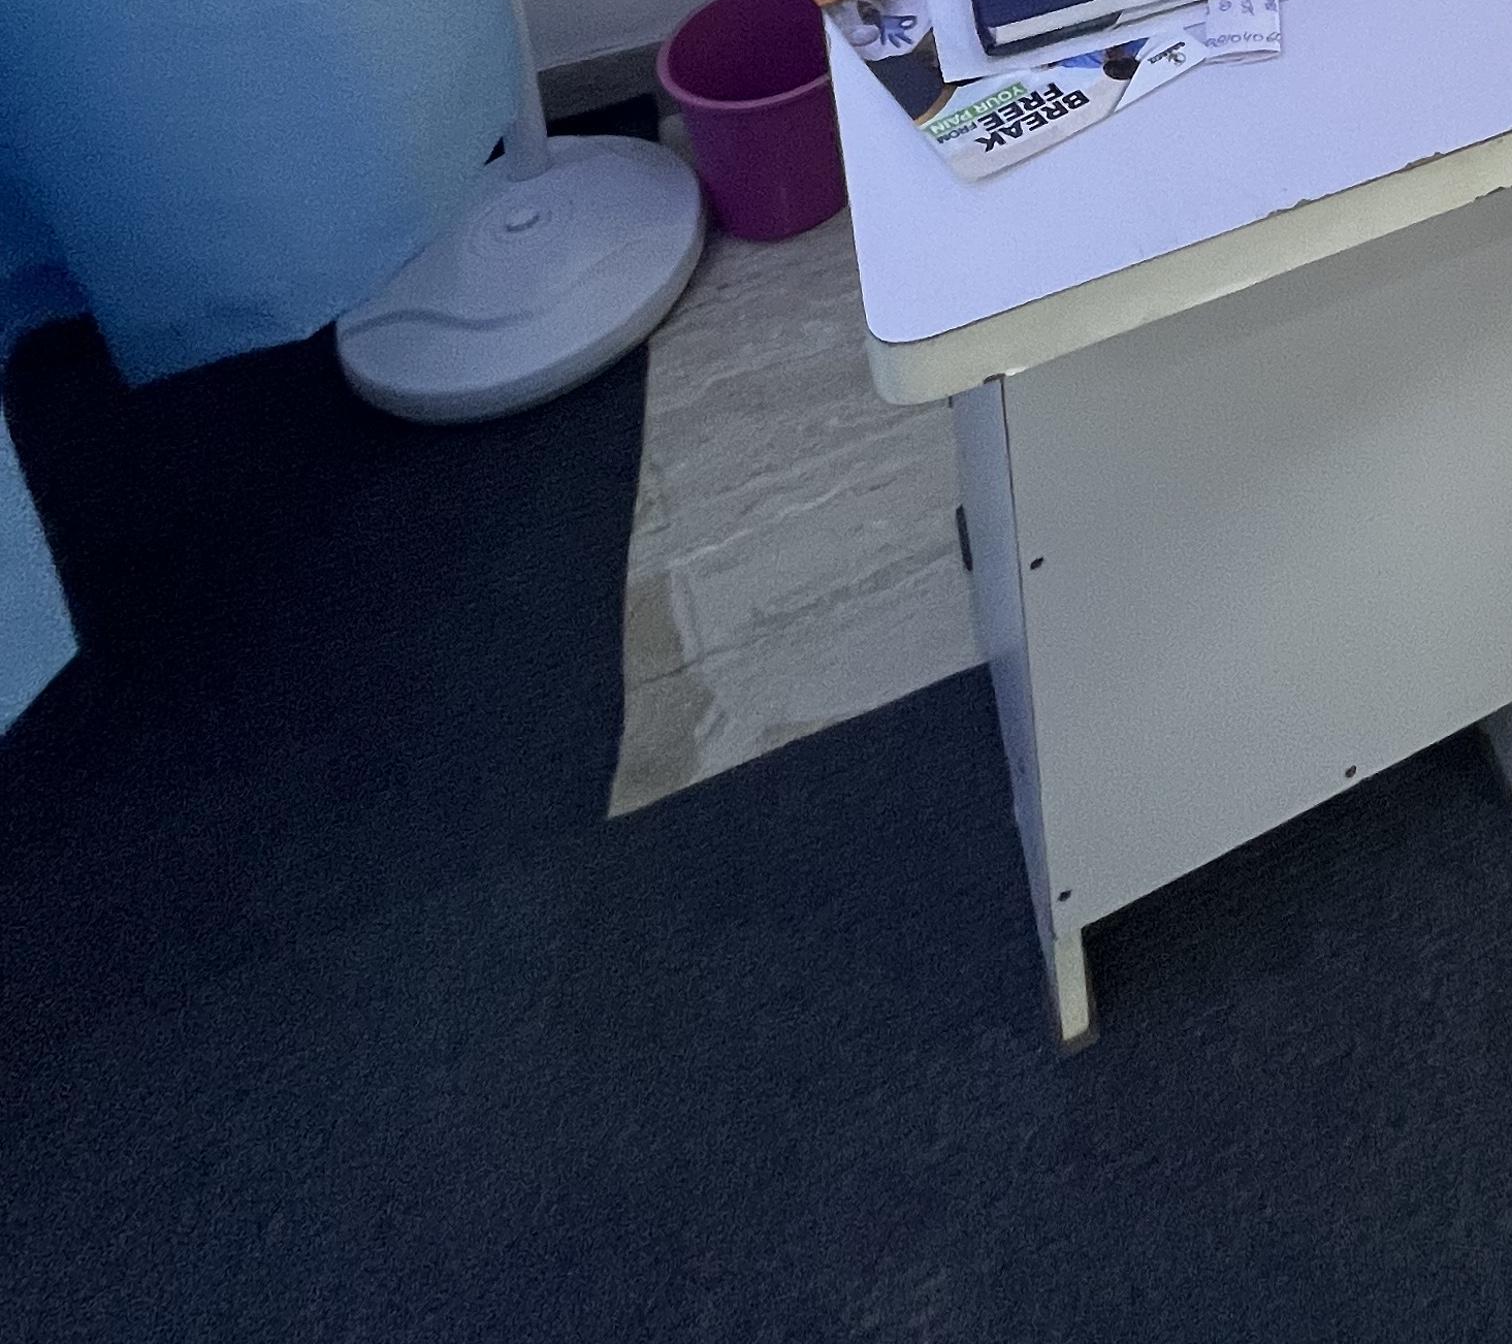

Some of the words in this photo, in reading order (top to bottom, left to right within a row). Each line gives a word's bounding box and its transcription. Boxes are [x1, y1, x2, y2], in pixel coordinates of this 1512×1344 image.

[973, 84, 1026, 113] YOUR
[978, 82, 1065, 132] FREE
[929, 109, 974, 136] PAIN
[936, 121, 978, 145] FROM
[974, 89, 1091, 153] BREAK
